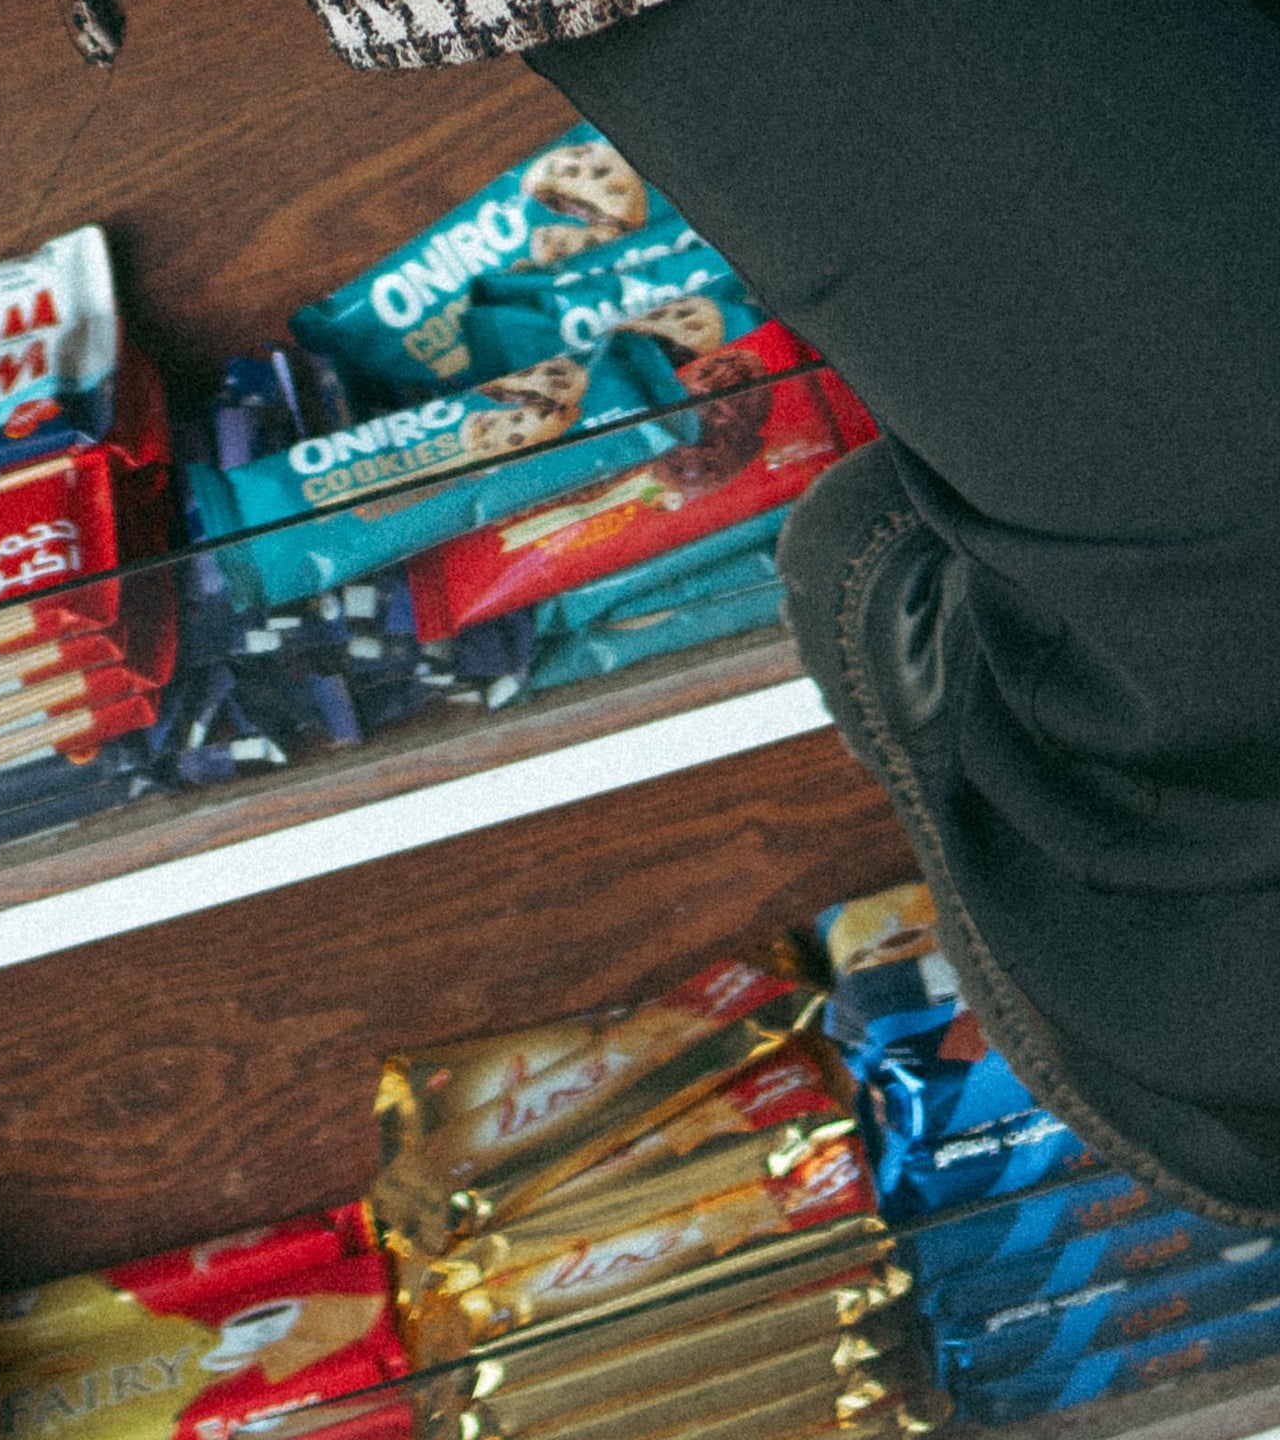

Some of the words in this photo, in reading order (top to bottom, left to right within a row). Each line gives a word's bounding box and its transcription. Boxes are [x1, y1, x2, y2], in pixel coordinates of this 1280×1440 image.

[371, 200, 528, 327] ONIRO
[290, 399, 465, 475] ONIRO
[303, 436, 461, 505] COOKIES
[0, 1344, 196, 1434] FAIRY
